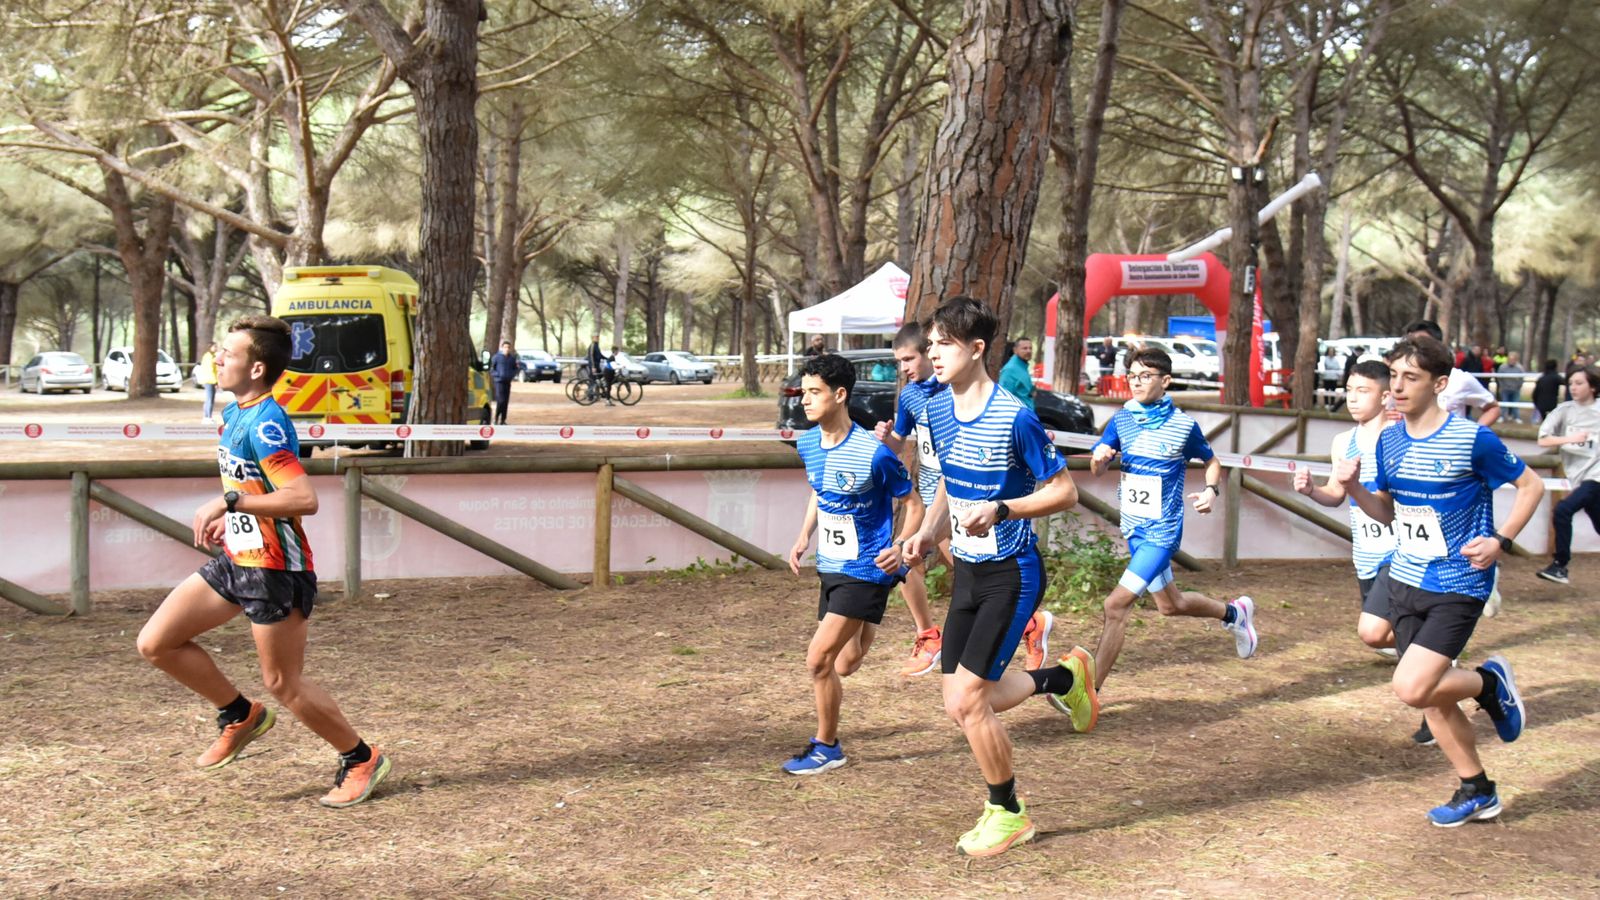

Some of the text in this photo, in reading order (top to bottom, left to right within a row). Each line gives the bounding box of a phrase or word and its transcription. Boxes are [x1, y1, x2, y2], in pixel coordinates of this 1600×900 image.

[289, 299, 373, 311] AMBULANCIA
[1128, 488, 1151, 505] 32
[824, 527, 846, 546] 75
[1403, 522, 1430, 541] 74
